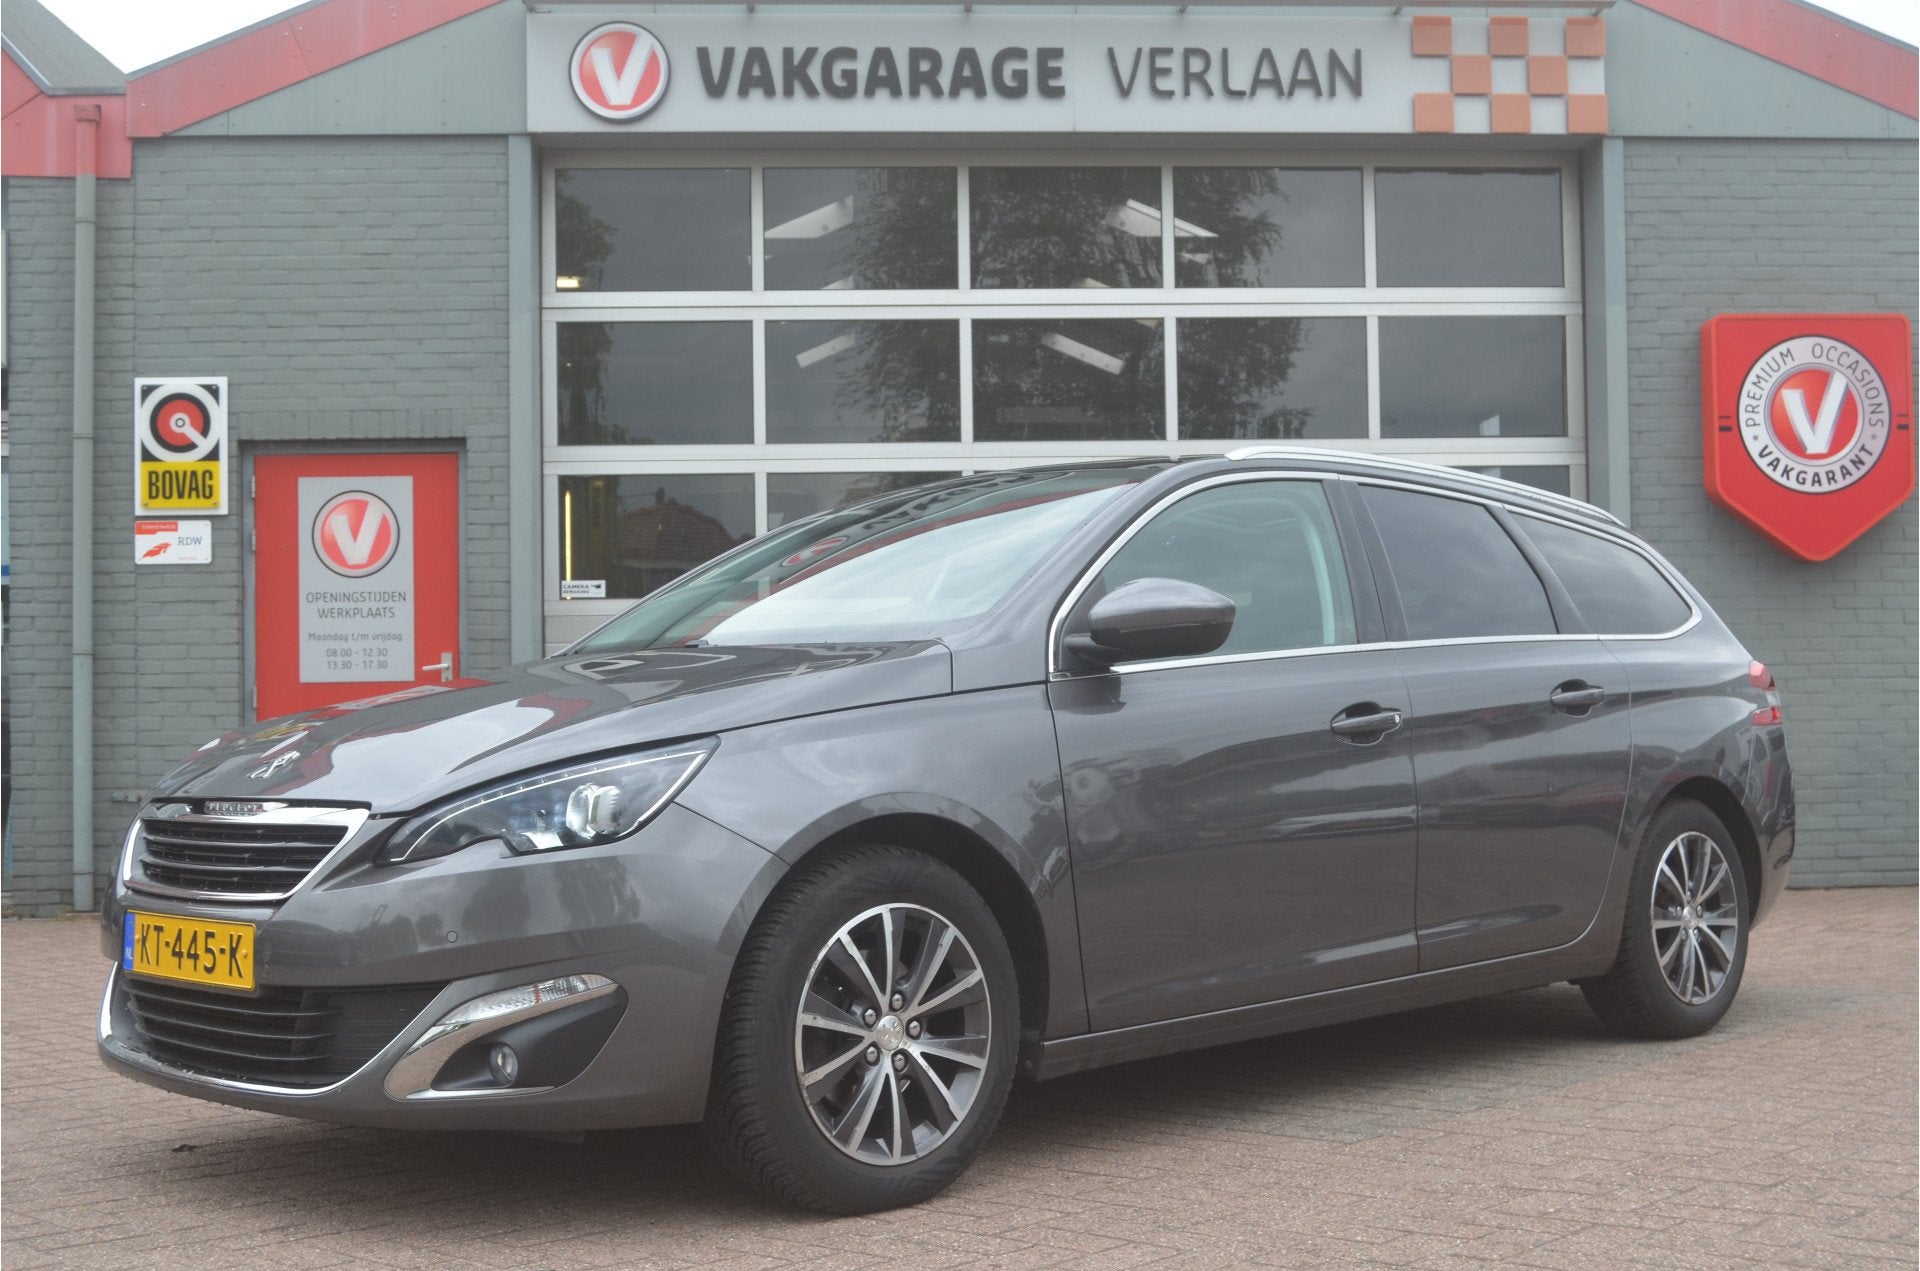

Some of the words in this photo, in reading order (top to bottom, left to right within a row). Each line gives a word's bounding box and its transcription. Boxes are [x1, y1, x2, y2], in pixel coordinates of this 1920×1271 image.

[696, 46, 1067, 99] VAKGARAGE
[1107, 47, 1363, 98] VERLAAN
[1745, 347, 1796, 428] PREMIUM
[1811, 342, 1885, 428] OCCASIONS
[1757, 443, 1874, 487] VAKGARANT
[148, 469, 214, 500] BOVAG
[177, 536, 203, 546] RDW
[305, 591, 407, 603] OPENINGSTIJDEN
[317, 607, 396, 619] WERKPLAATS
[308, 632, 349, 643] Maandag
[351, 632, 369, 642] t/m
[371, 632, 403, 643] vrijdag
[325, 648, 352, 658] 08.00
[361, 647, 389, 657] 12.30
[325, 660, 353, 670] 13.30
[361, 660, 389, 670] 17.30
[140, 922, 244, 978] KT-445-K
